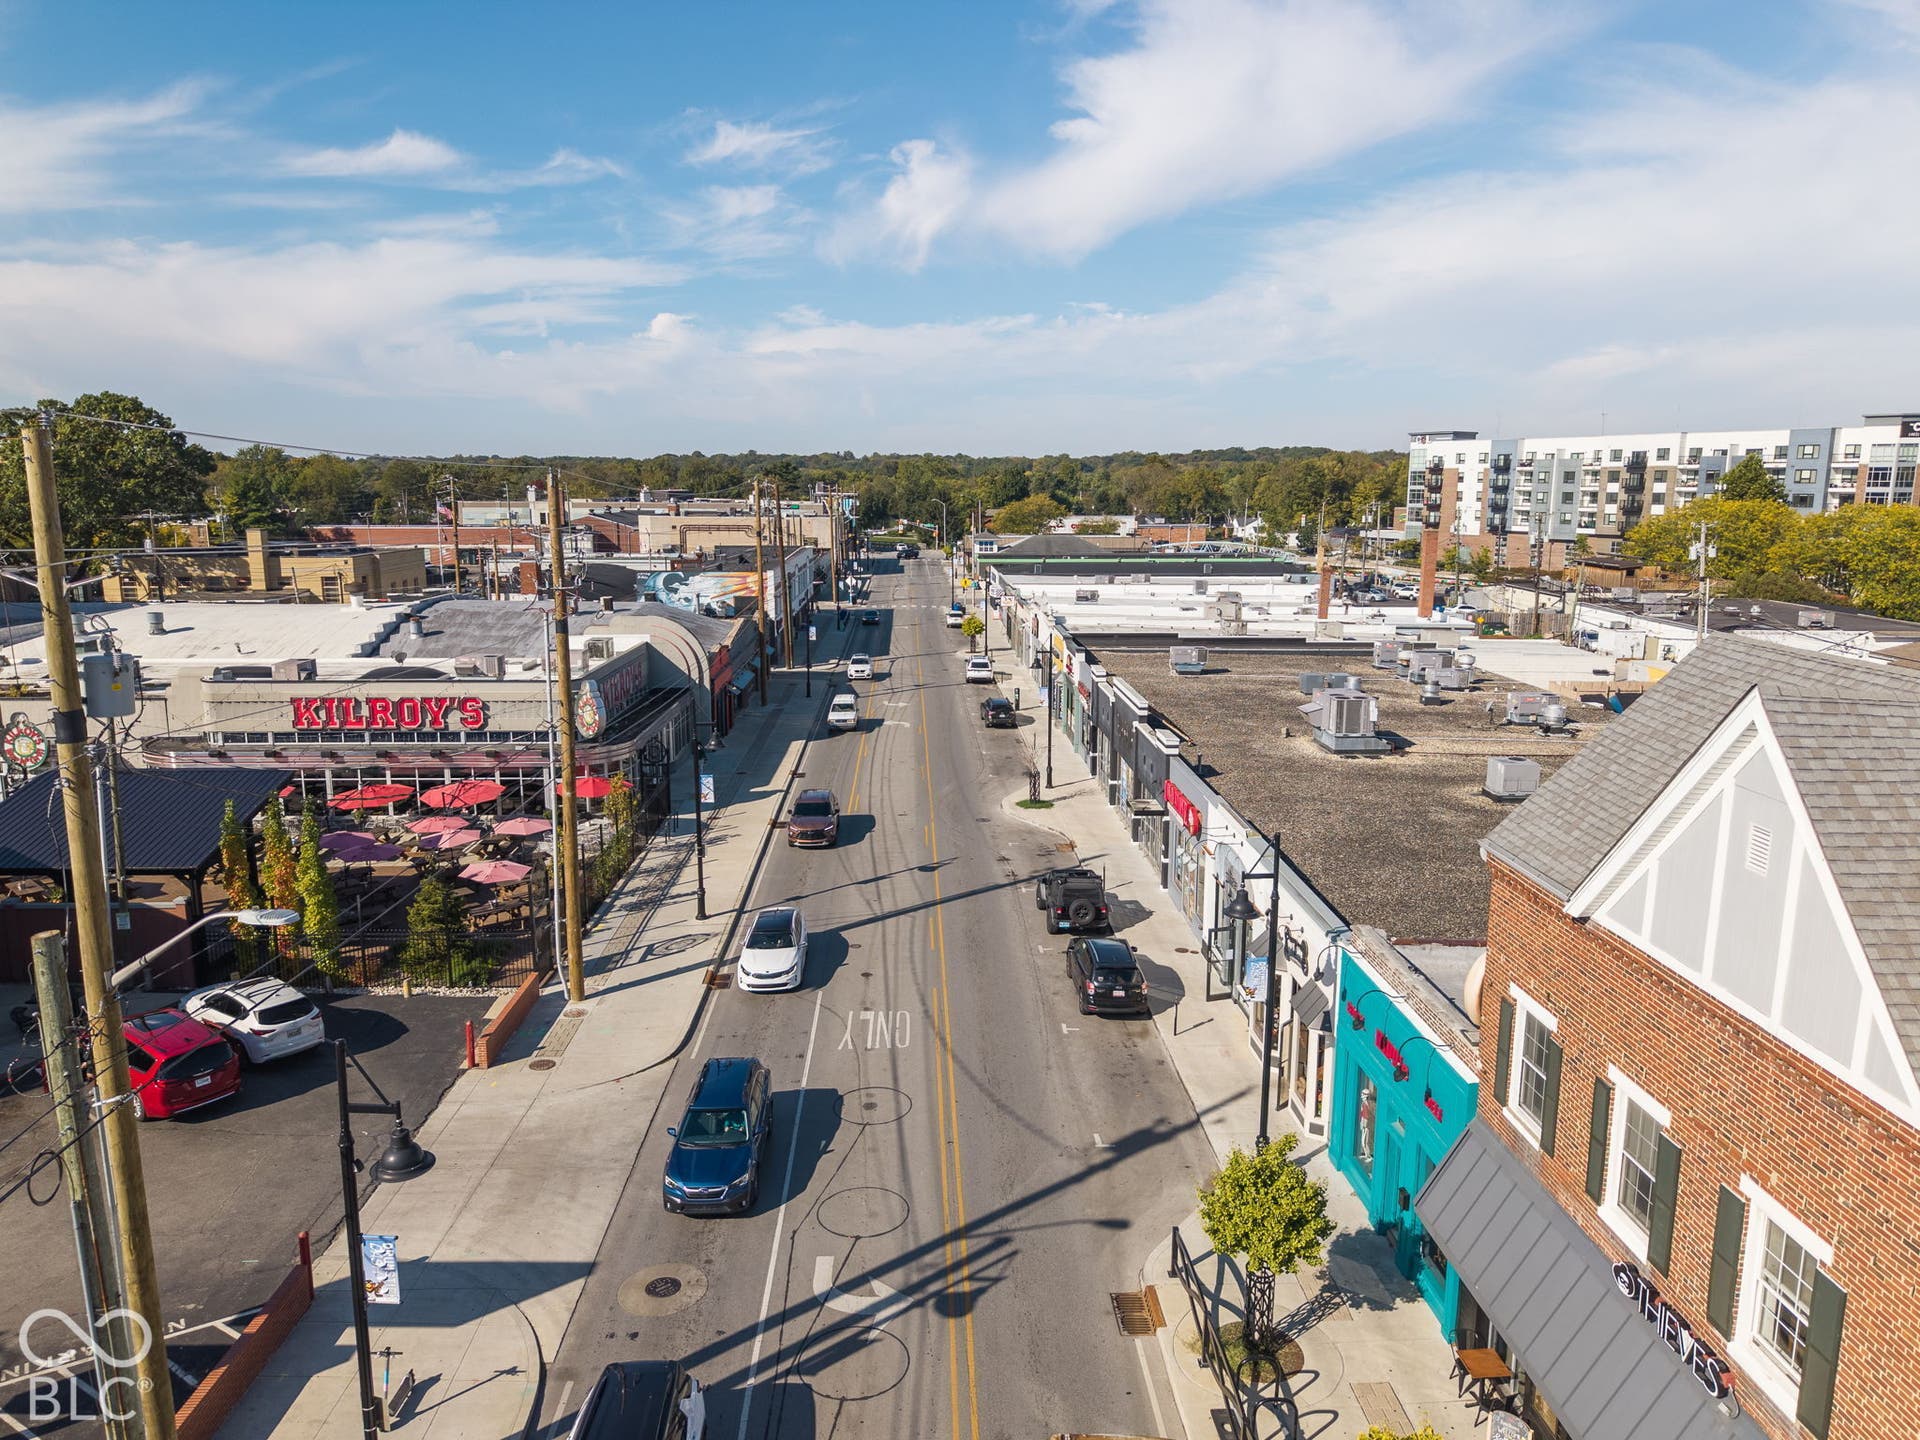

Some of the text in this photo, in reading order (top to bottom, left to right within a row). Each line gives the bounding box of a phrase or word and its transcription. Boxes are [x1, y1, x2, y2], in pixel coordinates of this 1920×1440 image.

[290, 696, 486, 729] KILROY'S
[837, 1010, 911, 1050] ONLY
[1636, 1277, 1720, 1397] THIEVES
